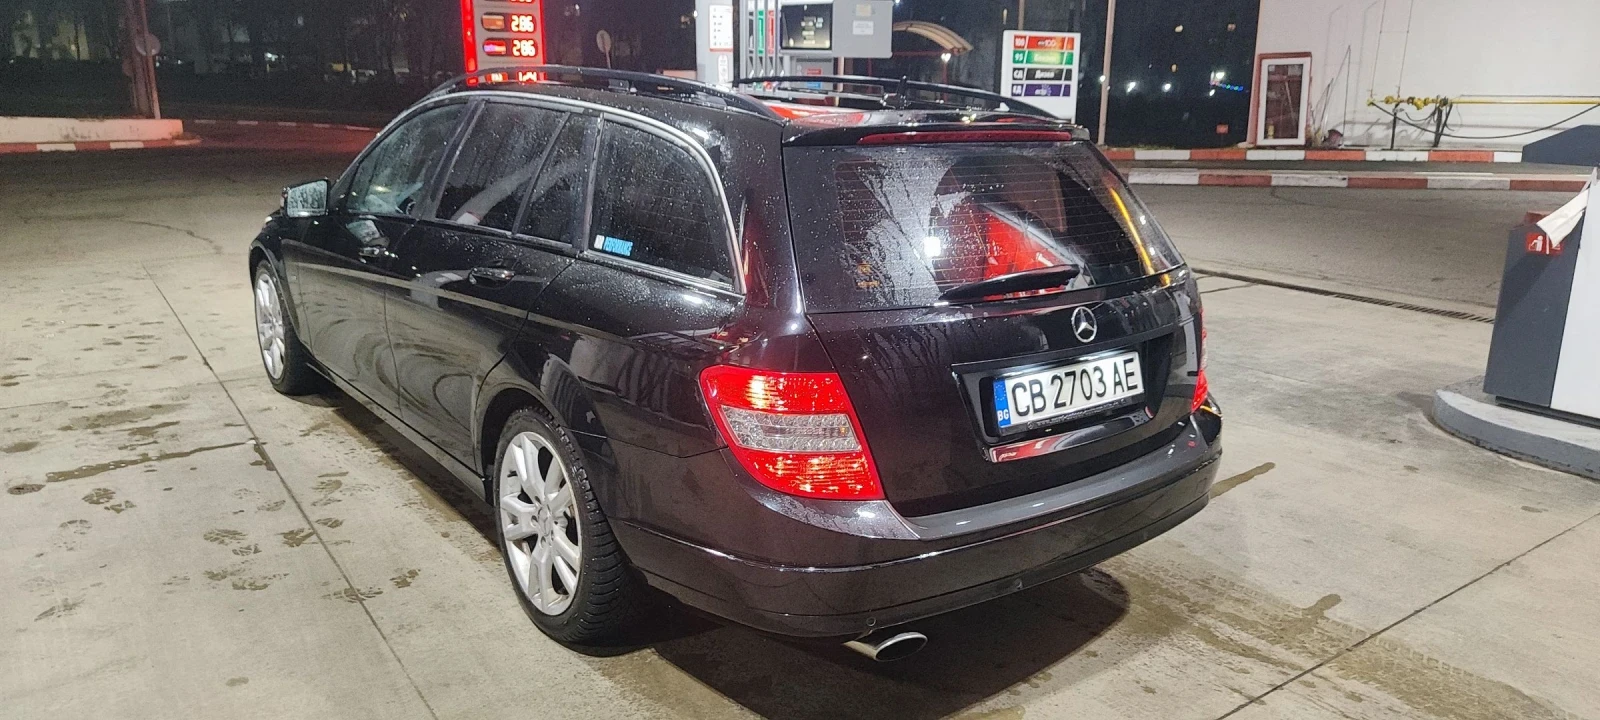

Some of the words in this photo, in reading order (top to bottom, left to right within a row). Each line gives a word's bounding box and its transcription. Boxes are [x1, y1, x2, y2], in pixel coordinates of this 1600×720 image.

[1014, 53, 1024, 62] 95
[1050, 365, 1107, 409] 2703
[997, 409, 1010, 421] BG
